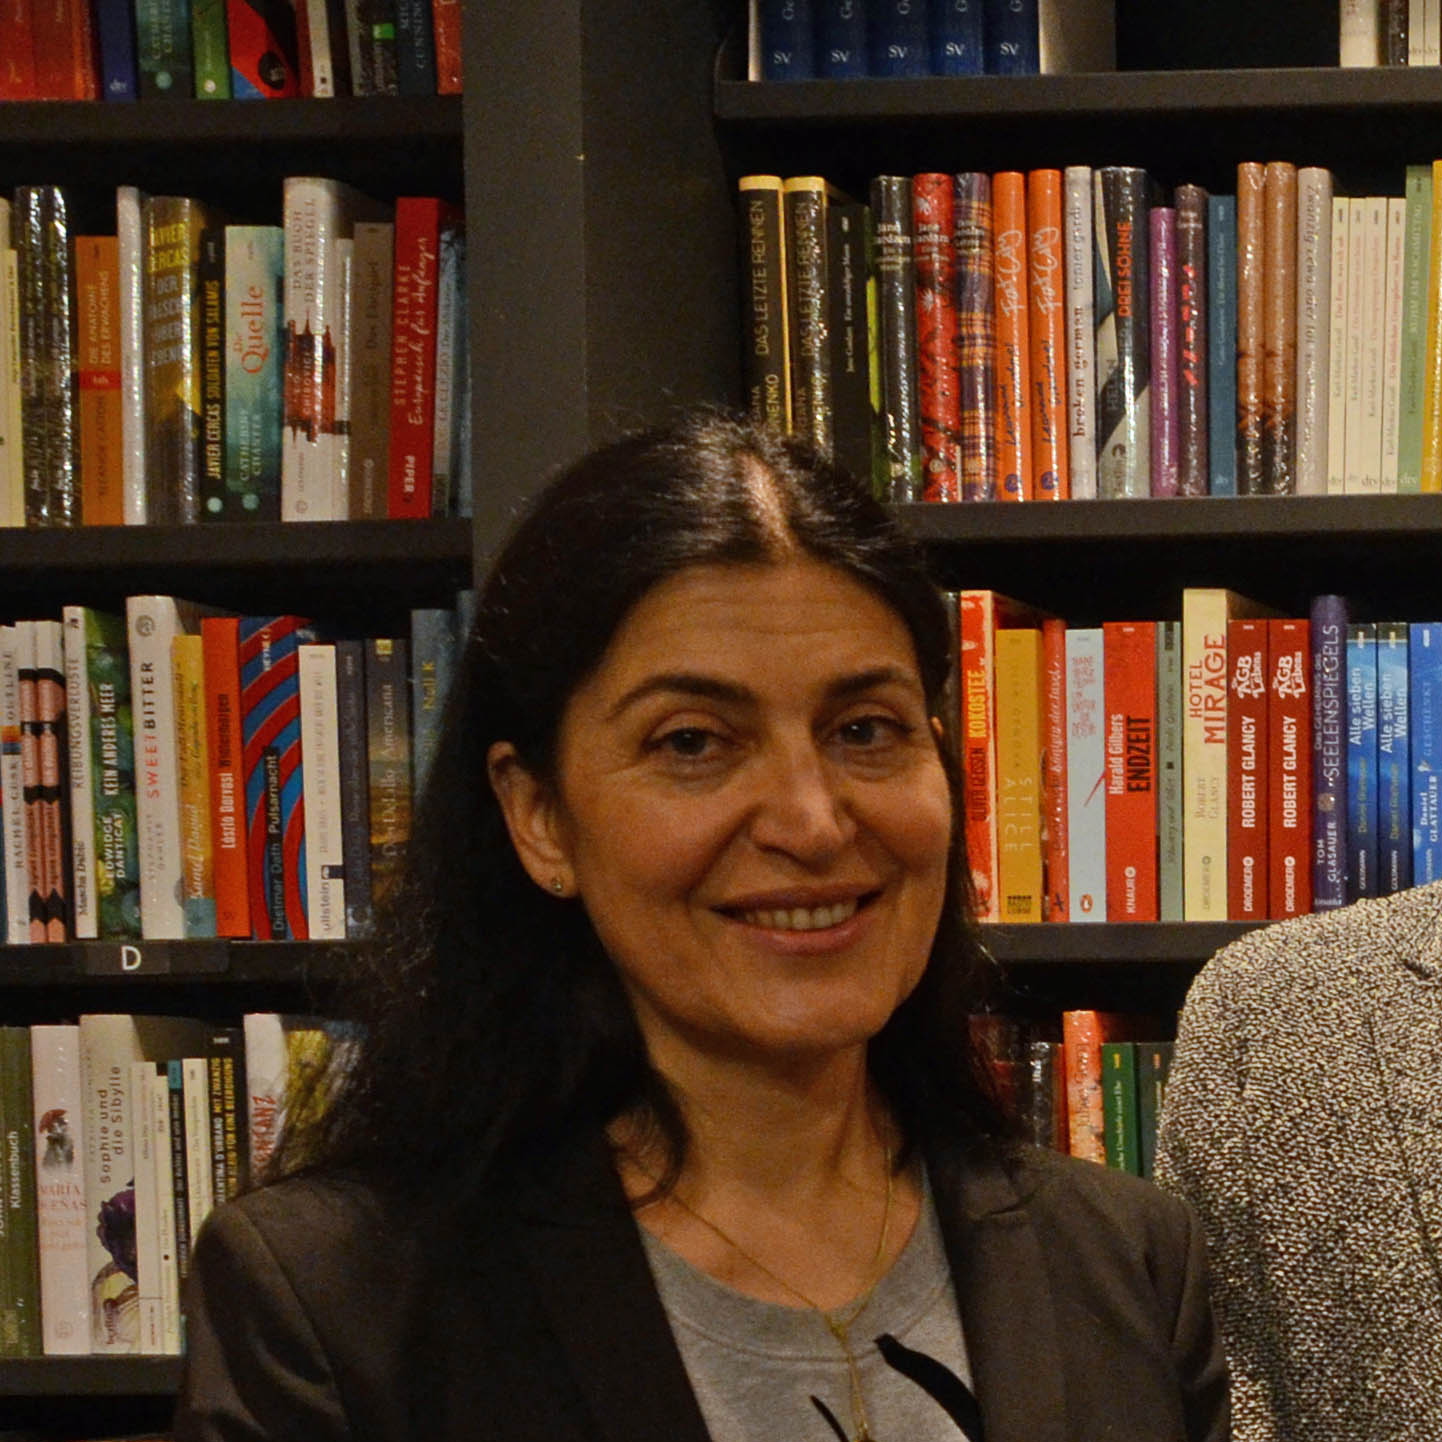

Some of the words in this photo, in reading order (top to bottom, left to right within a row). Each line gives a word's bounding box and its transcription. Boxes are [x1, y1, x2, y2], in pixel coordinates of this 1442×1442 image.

[750, 201, 766, 264] RENNEN
[1116, 222, 1132, 277] SÖHNE
[205, 280, 220, 324] SALAMIS
[753, 268, 768, 321] LETZTE
[1116, 280, 1132, 317] DREI
[205, 327, 220, 347] VON
[240, 285, 270, 374] Quelle
[755, 325, 769, 355] DAS
[1072, 307, 1087, 370] german
[205, 351, 220, 399] SOLDATEN
[394, 336, 410, 406] STEPHEN
[206, 403, 222, 441] CERCAS
[1072, 379, 1087, 436] broken
[206, 444, 222, 479] JAVIER
[404, 455, 416, 492] PIPER
[100, 684, 118, 713] MEER
[1190, 664, 1202, 718] HOTEL
[1204, 634, 1225, 744] MIRAGE
[1235, 656, 1251, 698] AGB
[1277, 656, 1292, 698] AGB
[1350, 667, 1362, 713] sieben
[1380, 673, 1393, 720] sieben
[967, 670, 984, 738] KOKOSTEE
[1322, 624, 1340, 778] SEELENSPIEGELS
[1362, 683, 1375, 730] Wellen
[1394, 689, 1407, 738] Wellen
[1423, 681, 1433, 757] GESCHENKT
[100, 718, 118, 763] ANDERES
[1109, 714, 1123, 754] Gilbers
[1127, 715, 1150, 793] ENDZEIT
[1242, 715, 1256, 771] GLANCY
[1282, 715, 1297, 771] GLANCY
[1350, 716, 1362, 745] Alle
[1380, 724, 1393, 753] Alle
[100, 769, 118, 796] KEIN
[219, 772, 236, 814] Darvasi
[265, 755, 279, 834] Pulsarnacht
[1109, 757, 1123, 795] Harald
[1242, 774, 1256, 828] ROBERT
[1282, 774, 1297, 828] ROBERT
[1419, 792, 1429, 826] Daniel
[1430, 775, 1438, 842] GLATTAUER
[113, 812, 125, 878] DANTICAT
[219, 816, 236, 849] László
[1317, 839, 1325, 864] TOM
[1326, 821, 1337, 882] GLASAUER
[269, 843, 283, 875] Dath
[269, 879, 283, 931] Dietmar
[1243, 867, 1253, 911] DROEMER
[1285, 866, 1295, 911] DROEMER
[121, 945, 141, 971] D
[98, 1089, 108, 1119] und
[110, 1066, 123, 1123] Sibylle
[100, 1126, 112, 1184] Sophie
[112, 1130, 124, 1155] die
[9, 1131, 21, 1208] Klassenbuch
